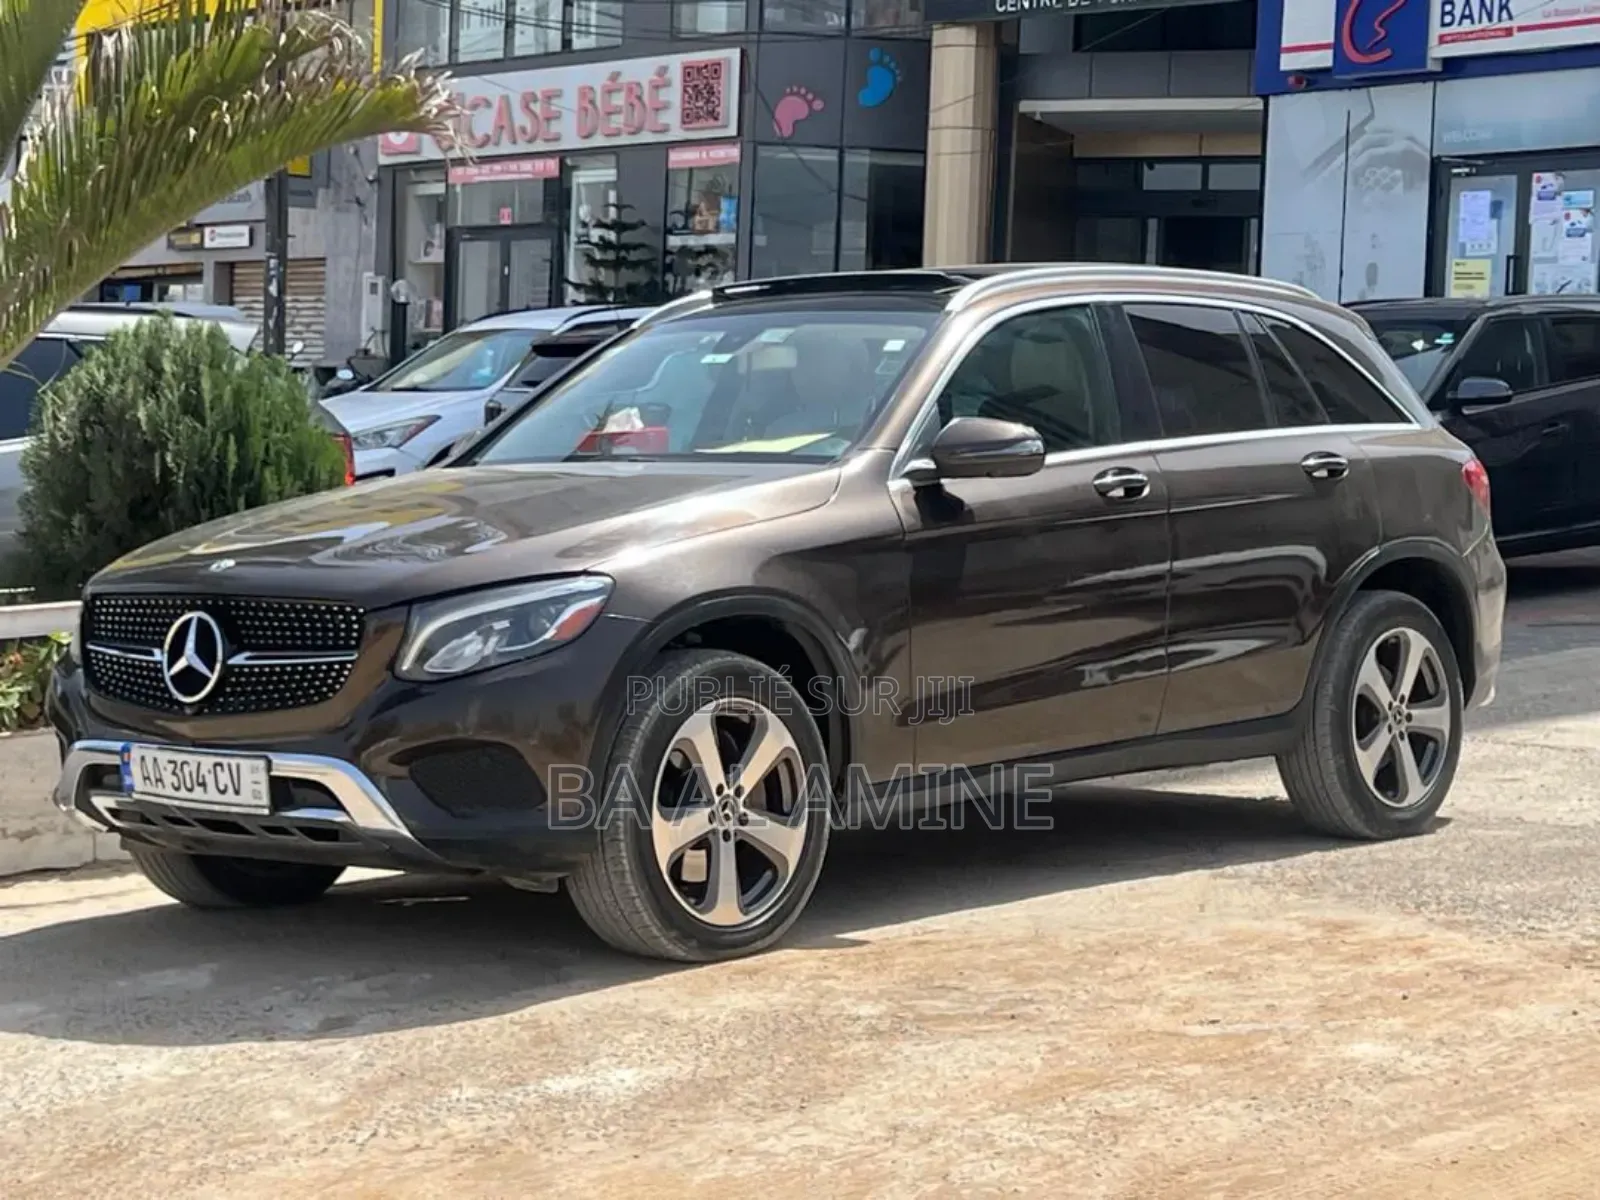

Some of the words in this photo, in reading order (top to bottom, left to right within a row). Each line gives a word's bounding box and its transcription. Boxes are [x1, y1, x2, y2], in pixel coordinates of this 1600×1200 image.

[1440, 0, 1514, 28] BANK
[577, 65, 672, 139] BÉBÉ
[140, 755, 166, 789] AA
[167, 759, 207, 794] 304
[212, 761, 241, 797] CV
